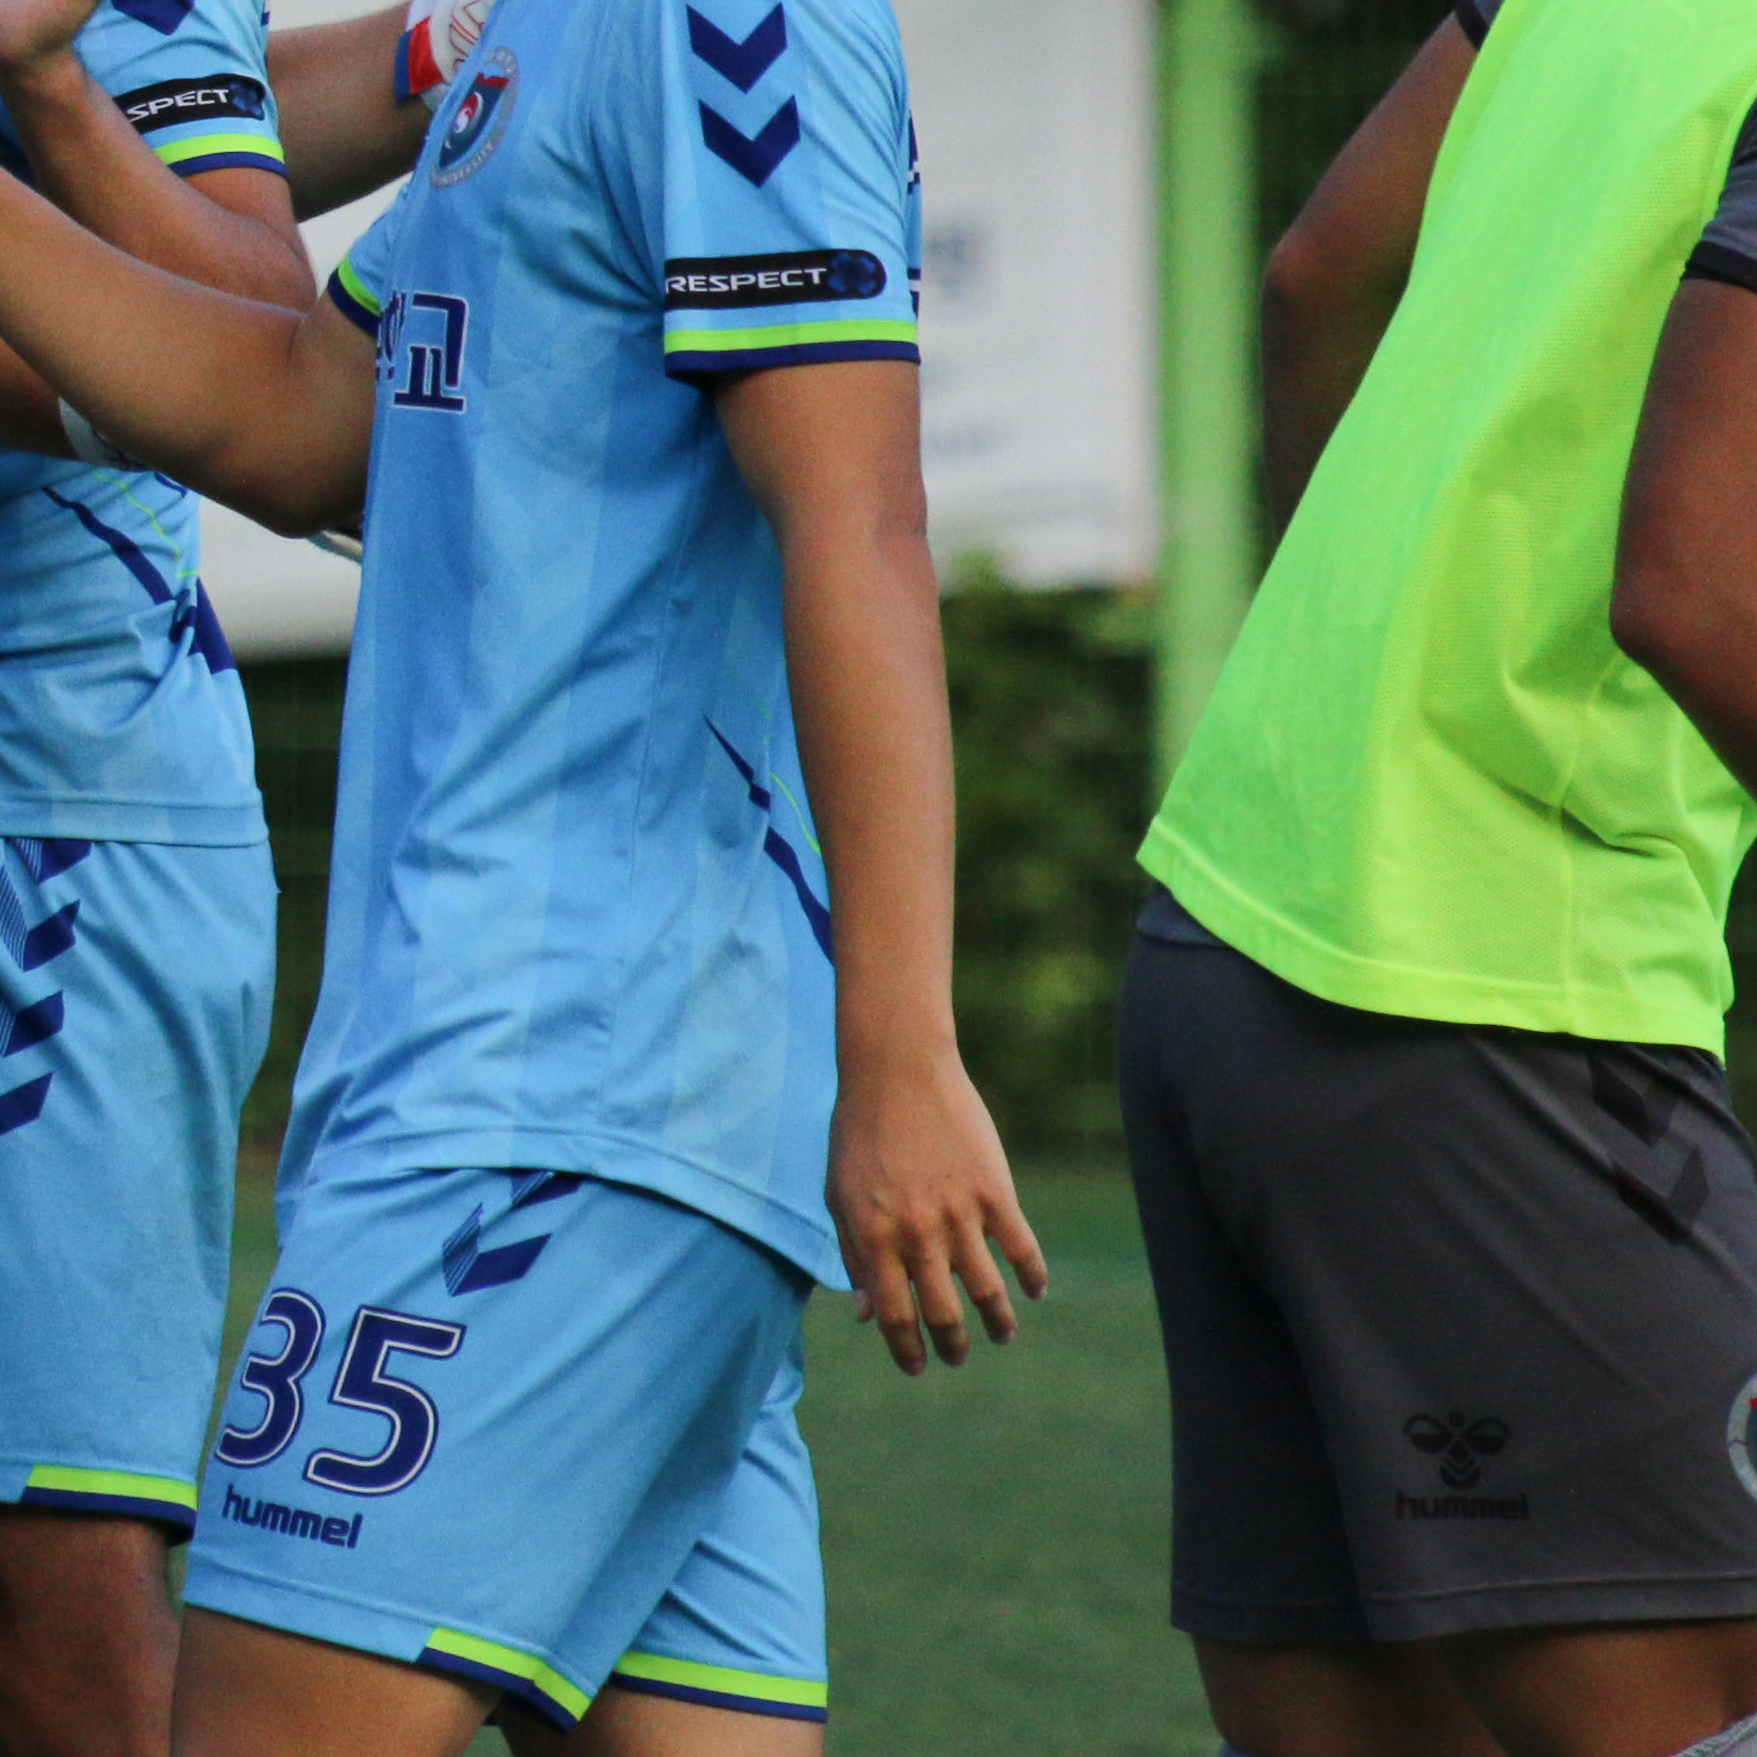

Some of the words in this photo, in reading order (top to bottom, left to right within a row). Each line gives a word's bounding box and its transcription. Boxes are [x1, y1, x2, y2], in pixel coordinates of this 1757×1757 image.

[126, 89, 229, 123] SPECT
[665, 267, 827, 293] RESPECT
[215, 1288, 467, 1498] 35
[221, 1484, 364, 1549] hummel
[1396, 1491, 1529, 1520] hummel
